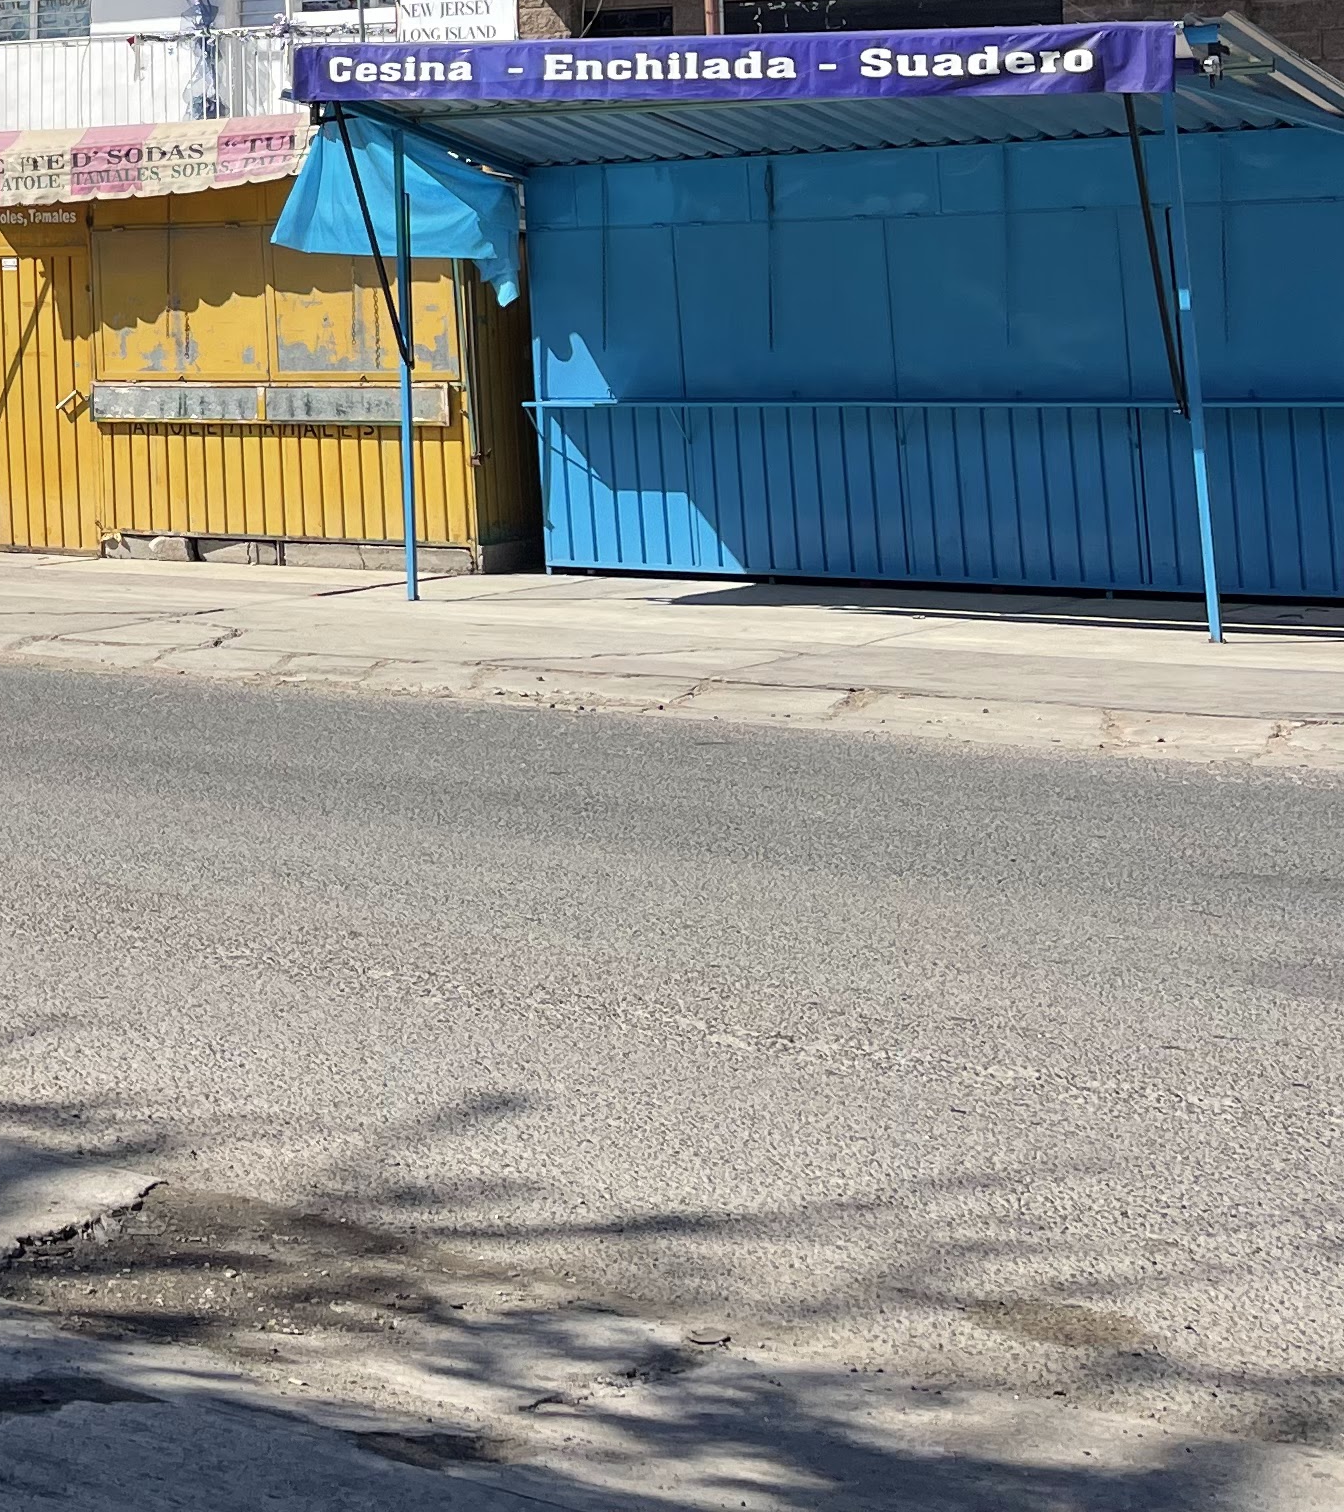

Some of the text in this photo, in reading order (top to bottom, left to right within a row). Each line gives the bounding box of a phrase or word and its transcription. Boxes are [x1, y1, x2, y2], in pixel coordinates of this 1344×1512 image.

[401, 0, 493, 18] NEW JERSEY
[402, 24, 497, 42] LONG ISLAND
[328, 56, 472, 83] Cesina
[543, 50, 797, 82] Enchilada
[859, 45, 1095, 78] Suadero
[106, 142, 205, 165] SODAS
[1, 173, 65, 192] ATOLE,
[72, 166, 162, 186] TAMALES,
[171, 161, 234, 179] SOPAS,
[28, 208, 77, 223] Tamales
